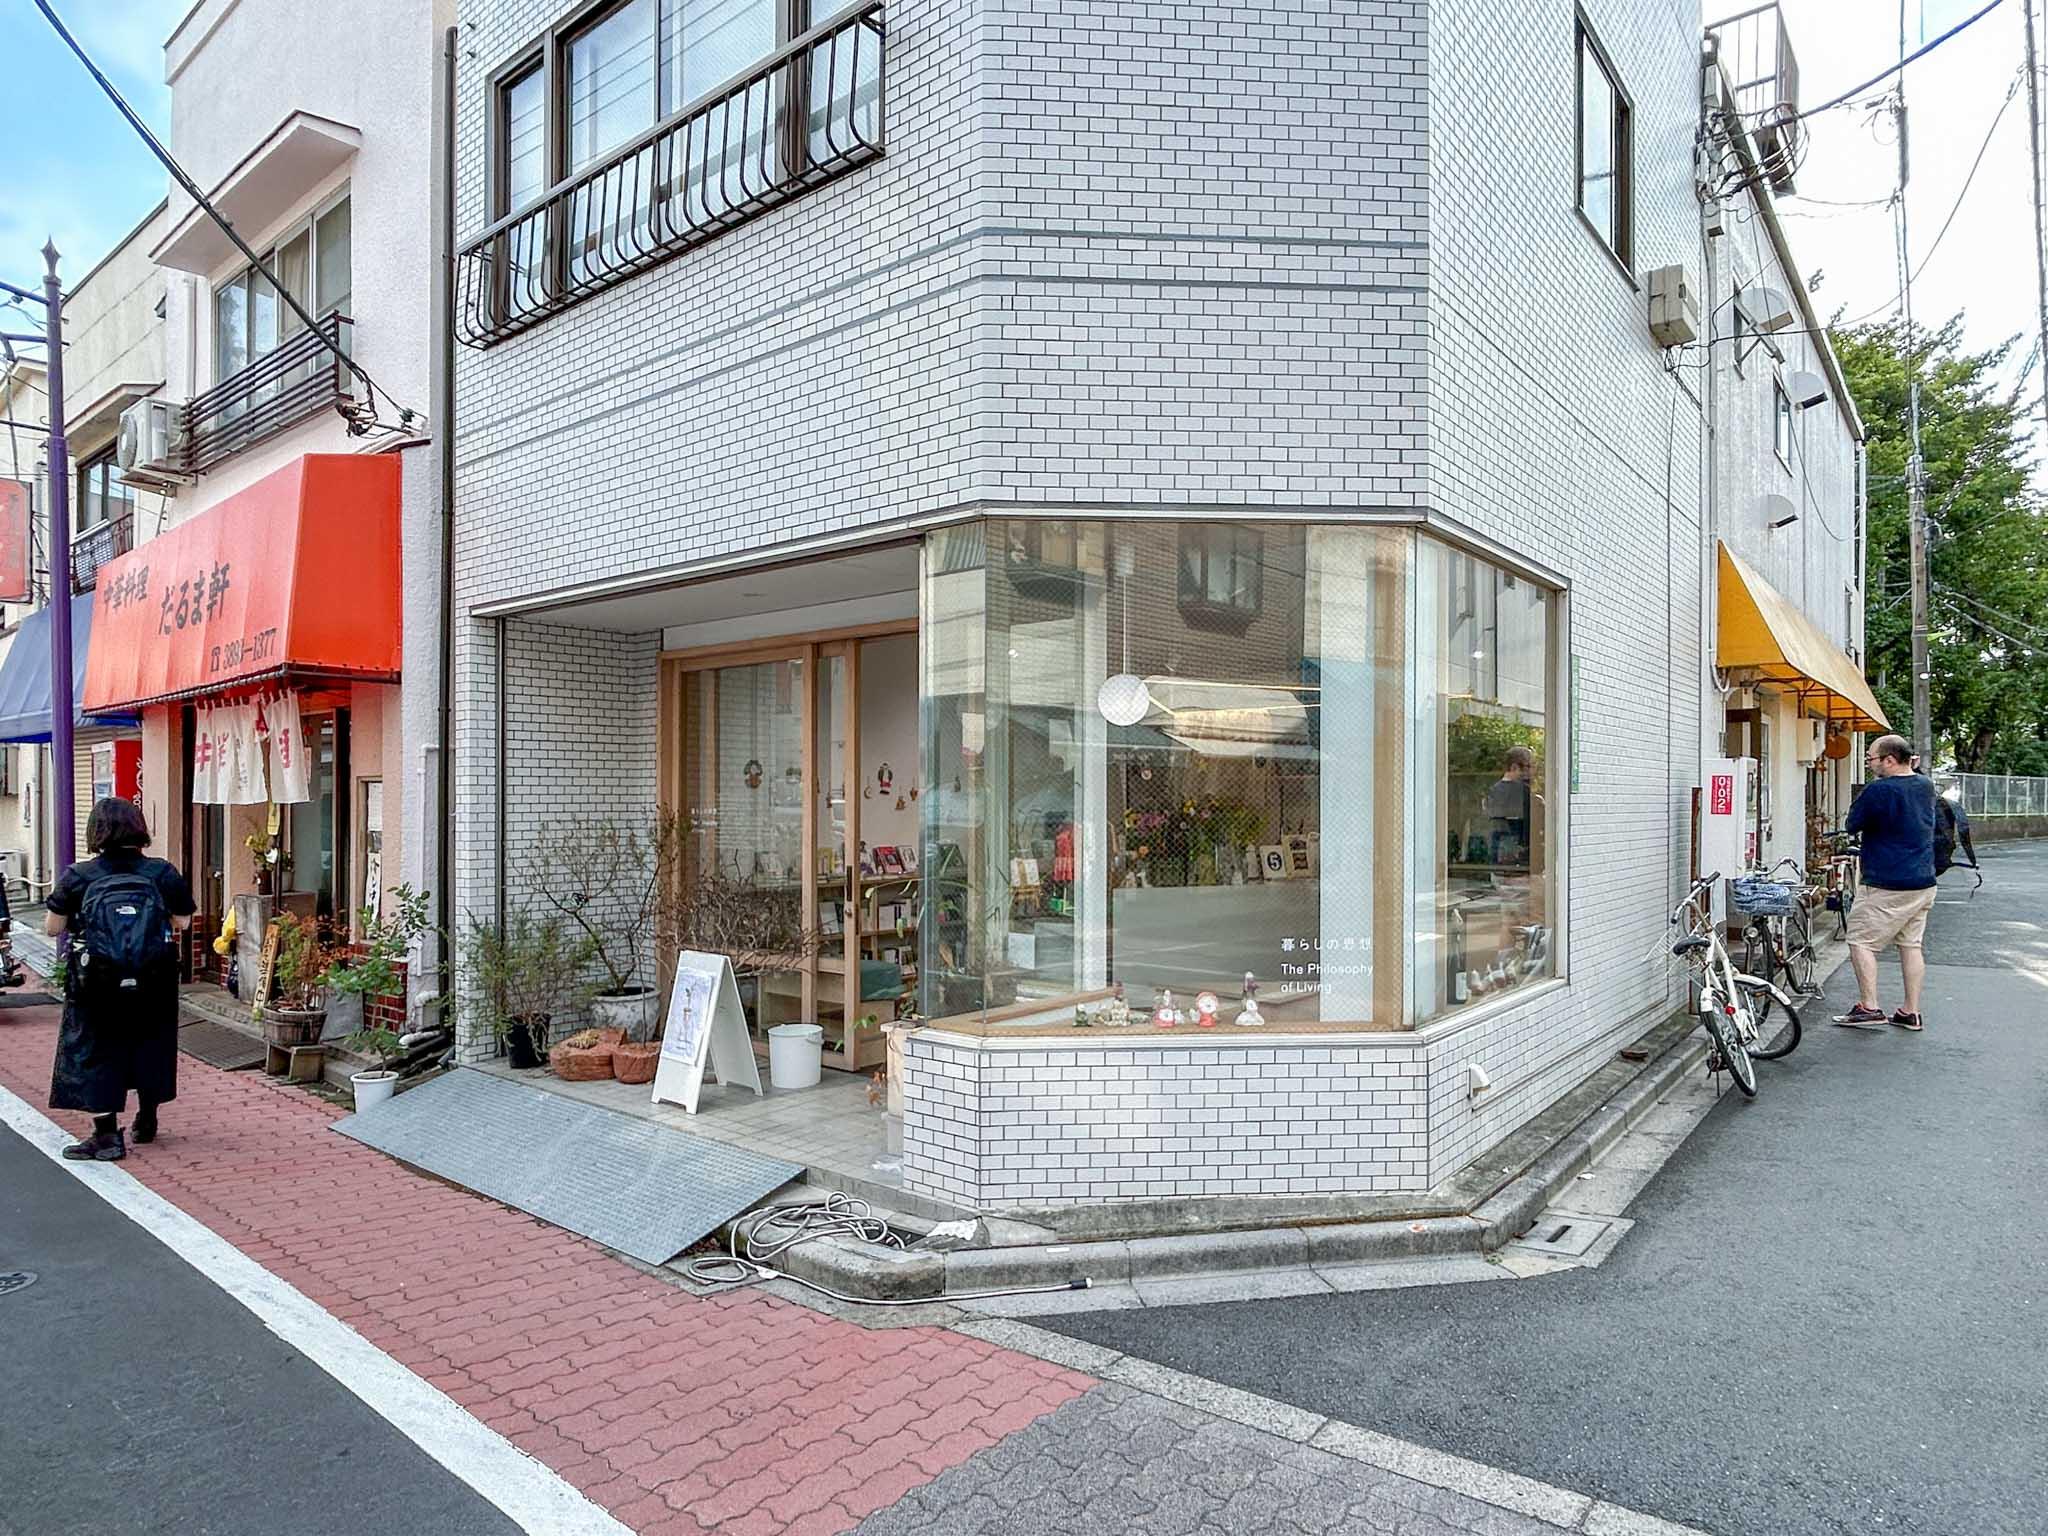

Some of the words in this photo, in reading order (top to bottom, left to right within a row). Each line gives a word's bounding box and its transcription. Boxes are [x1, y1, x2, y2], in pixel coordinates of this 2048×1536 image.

[103, 565, 149, 617] 中華料理
[158, 560, 230, 635] だるま軒
[1718, 777, 1726, 808] 002
[1281, 963, 1303, 974] The
[1307, 963, 1373, 976] Philosophy
[1281, 982, 1293, 993] of
[1296, 982, 1332, 994] Living
